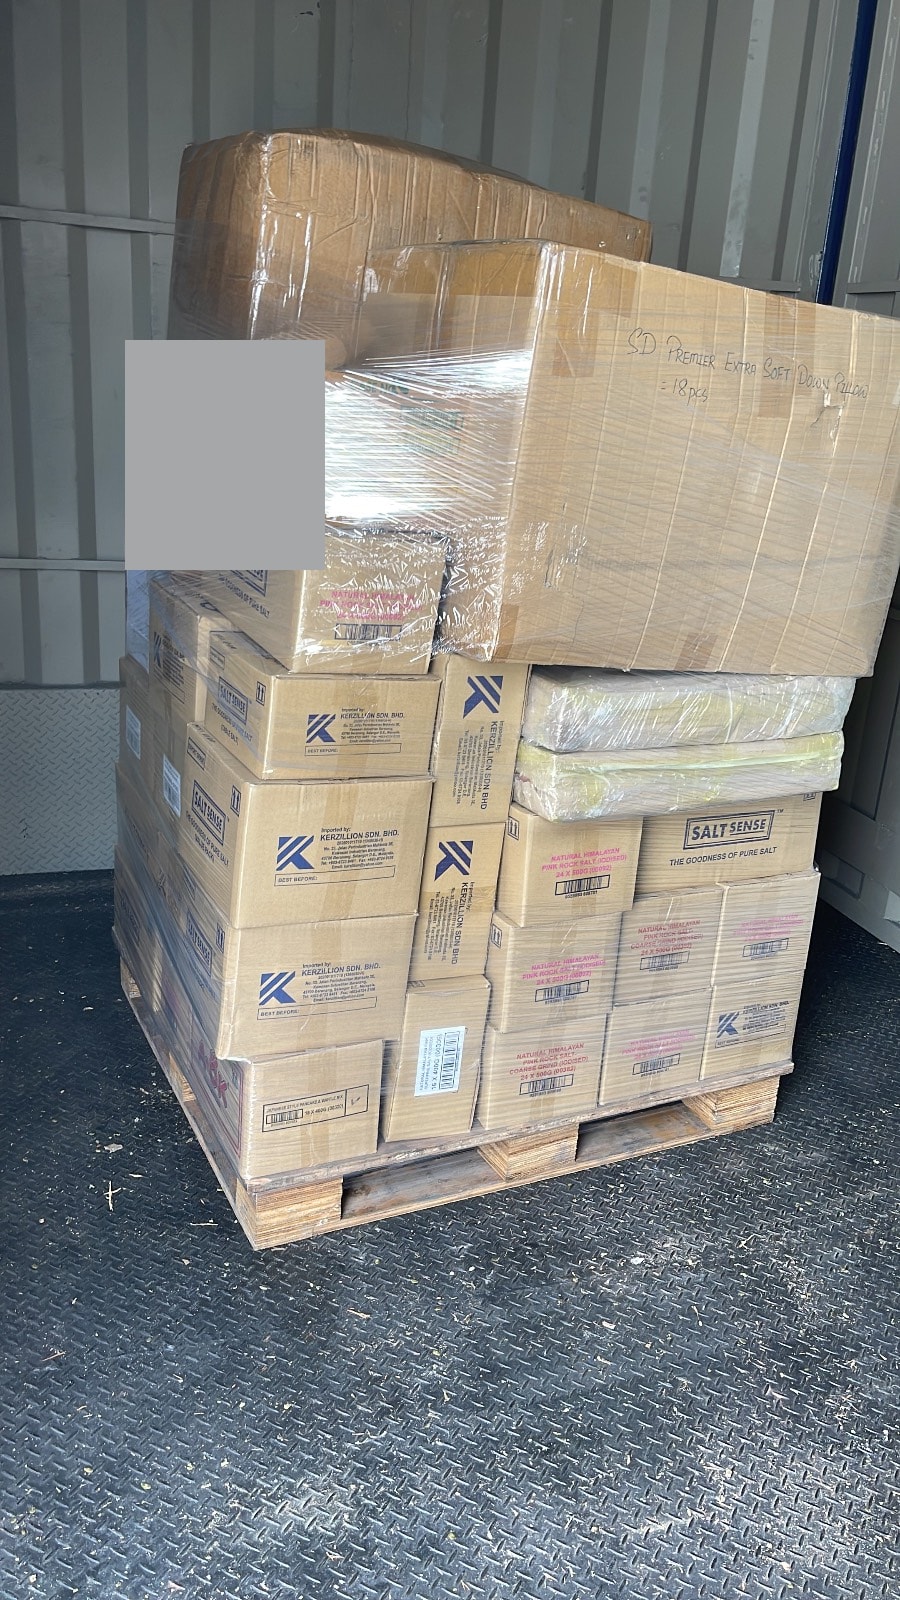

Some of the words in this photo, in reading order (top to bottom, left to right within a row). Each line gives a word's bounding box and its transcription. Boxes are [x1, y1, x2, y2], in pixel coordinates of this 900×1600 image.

[627, 327, 657, 355] SD
[194, 791, 207, 817] SALT
[207, 806, 223, 831] SENSE
[320, 832, 363, 841] KERZILLION
[382, 829, 399, 837] BHD.
[692, 824, 727, 840] SALT
[730, 818, 767, 833] SENSE
[551, 853, 582, 862] NATURAL
[584, 848, 620, 859] HIMALAYAN
[670, 858, 684, 866] THE
[686, 853, 726, 864] GOODNESS
[739, 849, 758, 858] PURE
[760, 846, 777, 855] SALT
[560, 861, 578, 870] ROCK
[580, 858, 597, 867] SALT
[456, 882, 468, 928] KERZILLION
[638, 926, 667, 934] NATURAL
[451, 949, 460, 965] BHD
[531, 962, 561, 970] NATURAL
[563, 954, 600, 964] HIMALAYAN
[302, 966, 345, 976] KERZILLION
[364, 962, 381, 970] BHD.
[516, 1050, 546, 1060] NATURAL
[548, 1043, 585, 1053] HIMALAYAN
[509, 1067, 537, 1075] COARSE
[538, 1062, 558, 1070] GRIND
